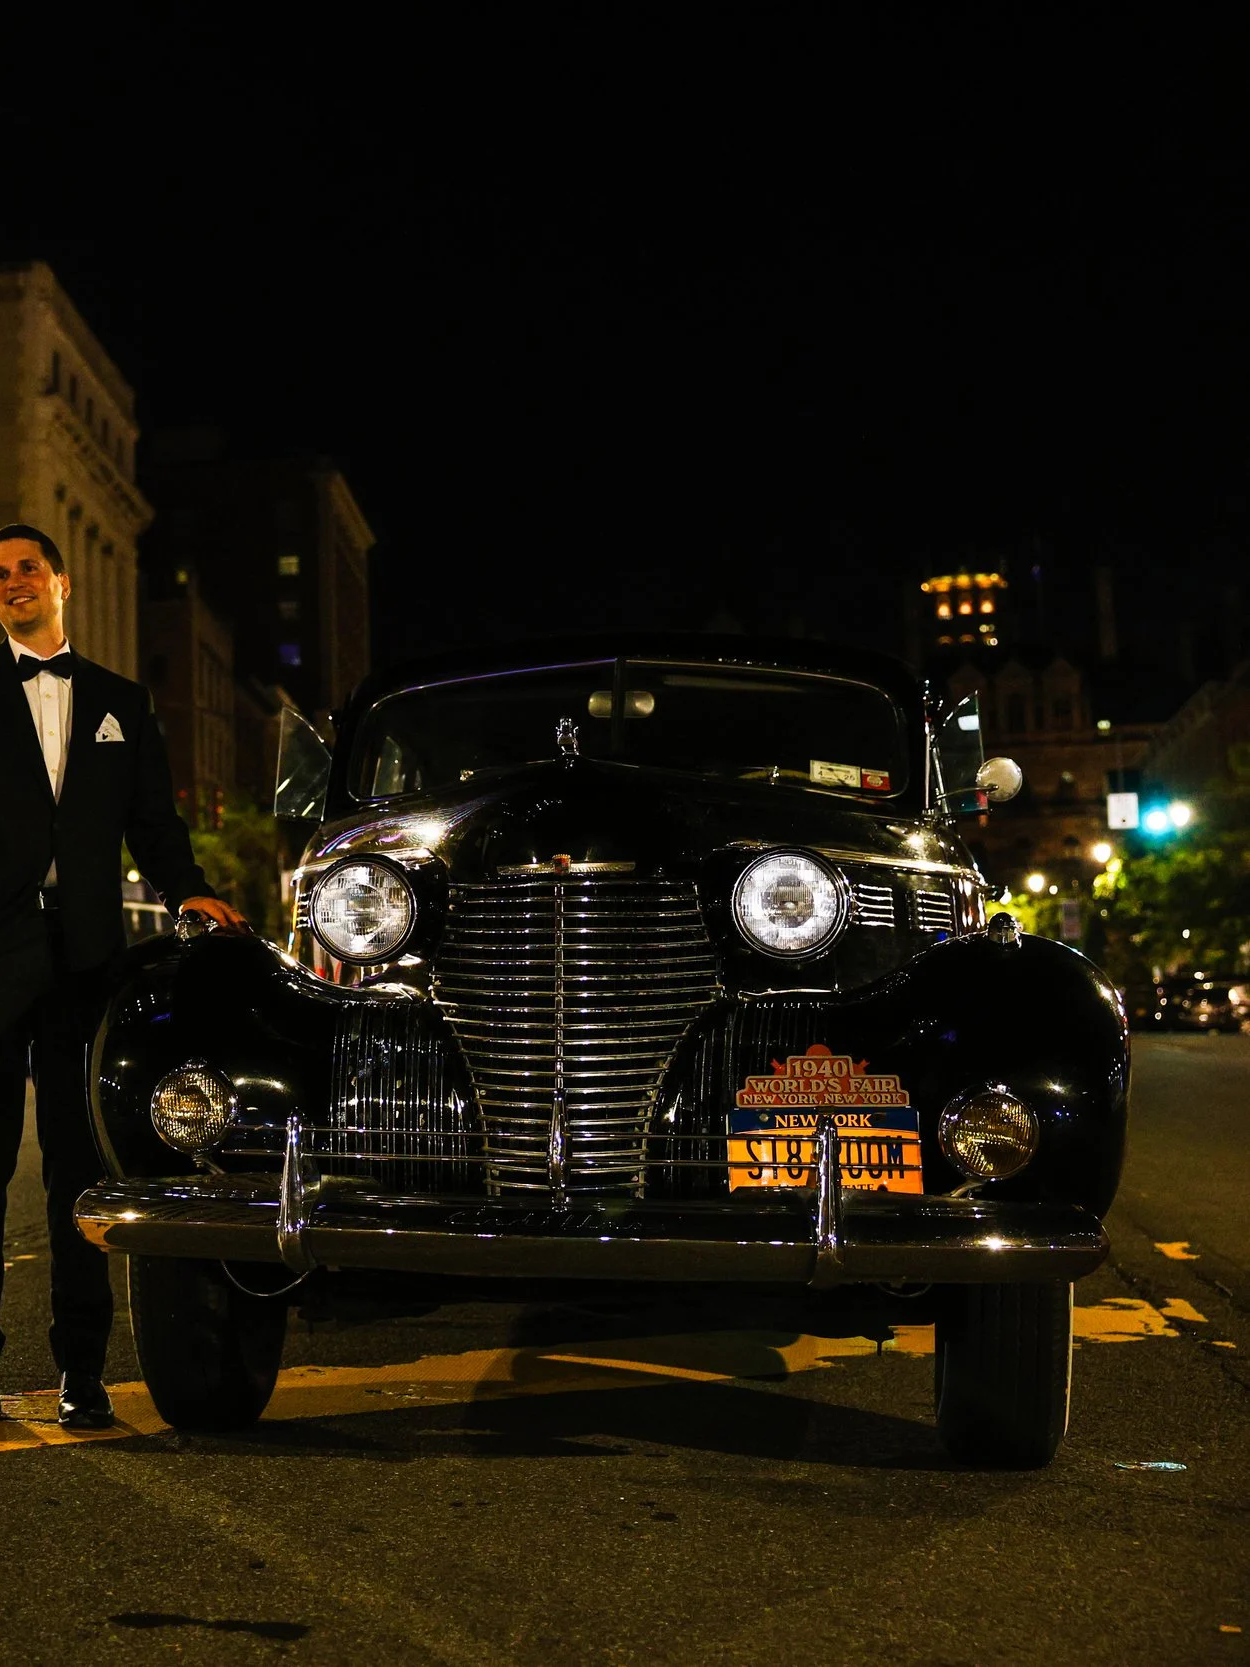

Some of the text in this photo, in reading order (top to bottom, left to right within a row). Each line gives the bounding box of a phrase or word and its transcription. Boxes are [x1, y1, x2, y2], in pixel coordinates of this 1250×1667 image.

[792, 1060, 848, 1078] 1940
[749, 1078, 896, 1093] WORLD'S FAIR
[743, 1093, 903, 1106] NEW YORK, NEW YORK
[775, 1114, 819, 1128] NEW
[836, 1136, 905, 1180] OOM
